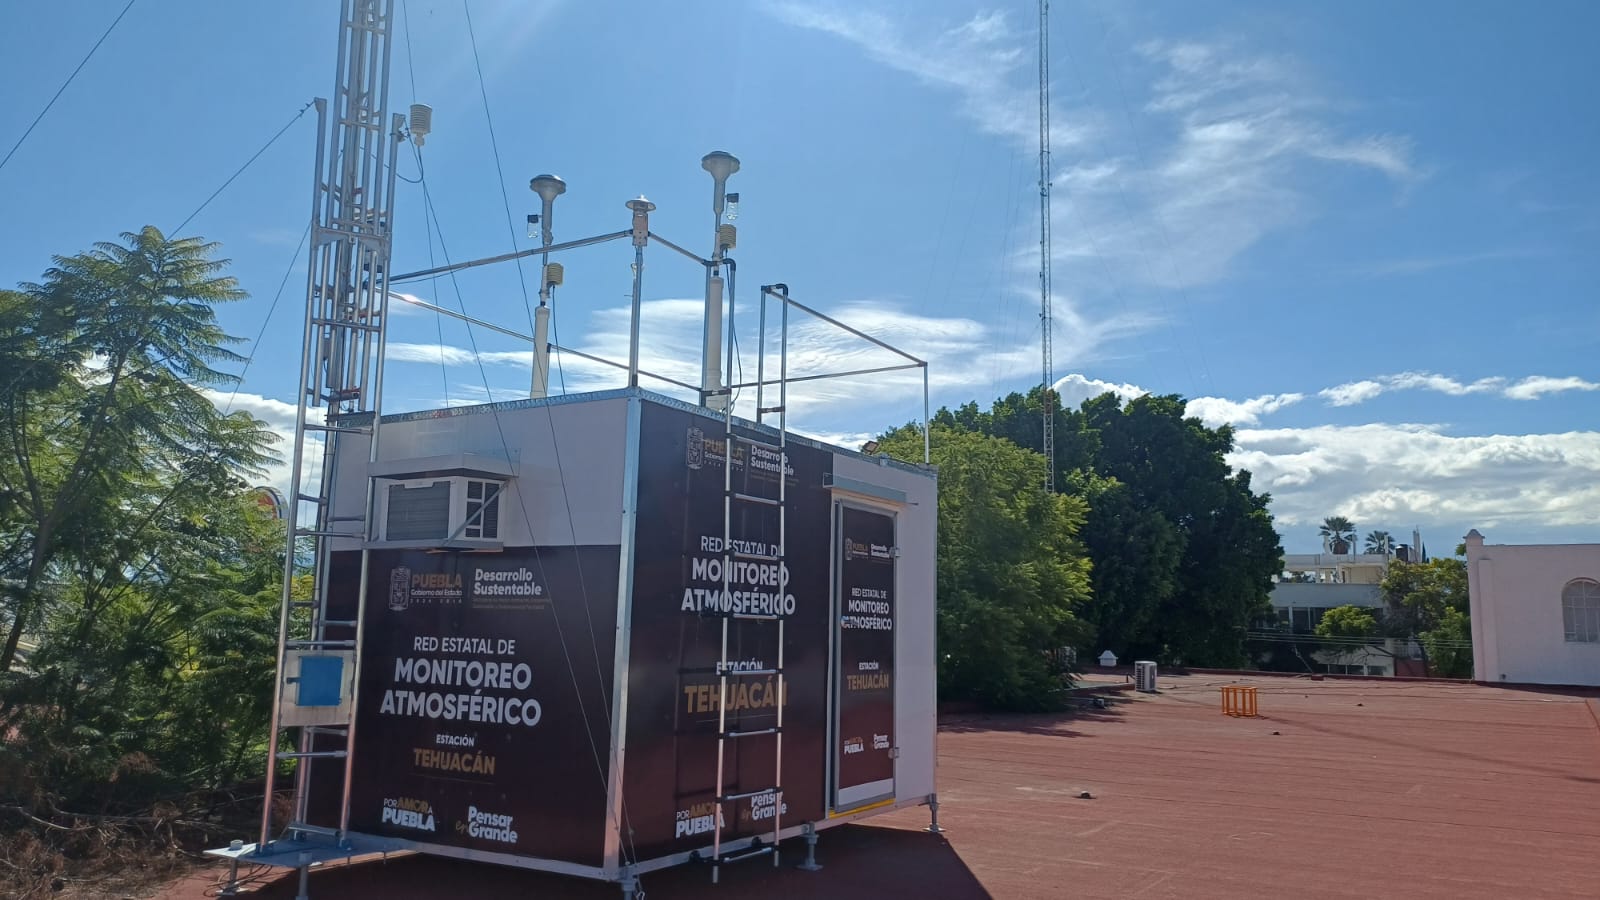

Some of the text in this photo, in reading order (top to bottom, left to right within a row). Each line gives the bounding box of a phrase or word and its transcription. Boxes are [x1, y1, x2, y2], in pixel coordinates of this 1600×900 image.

[751, 444, 789, 463] Desarroo
[751, 457, 794, 476] Sustentble
[701, 535, 724, 552] RED
[411, 573, 463, 588] PUEBLA
[475, 567, 533, 582] Desarrollo
[692, 557, 790, 587] MONITOREO
[473, 581, 542, 596] Sustentable
[680, 587, 796, 615] ATMOSFÉRICO
[848, 599, 890, 614] MONITOREO
[413, 636, 516, 655] RED ESTATAL DE
[394, 657, 532, 690] MONITOREO
[716, 657, 763, 675] ETACIÓN
[847, 671, 889, 691] TEHUACÁN
[684, 675, 788, 713] TEHUACÁN
[379, 689, 542, 726] ATMOSFÉRICO
[436, 734, 475, 747] ESTACIÓN
[413, 748, 496, 775] TEHUACÁN
[383, 798, 397, 808] POR
[751, 803, 787, 820] Grane
[381, 807, 436, 832] PUEBLA
[468, 805, 514, 828] Pensar
[468, 821, 518, 843] Grande
